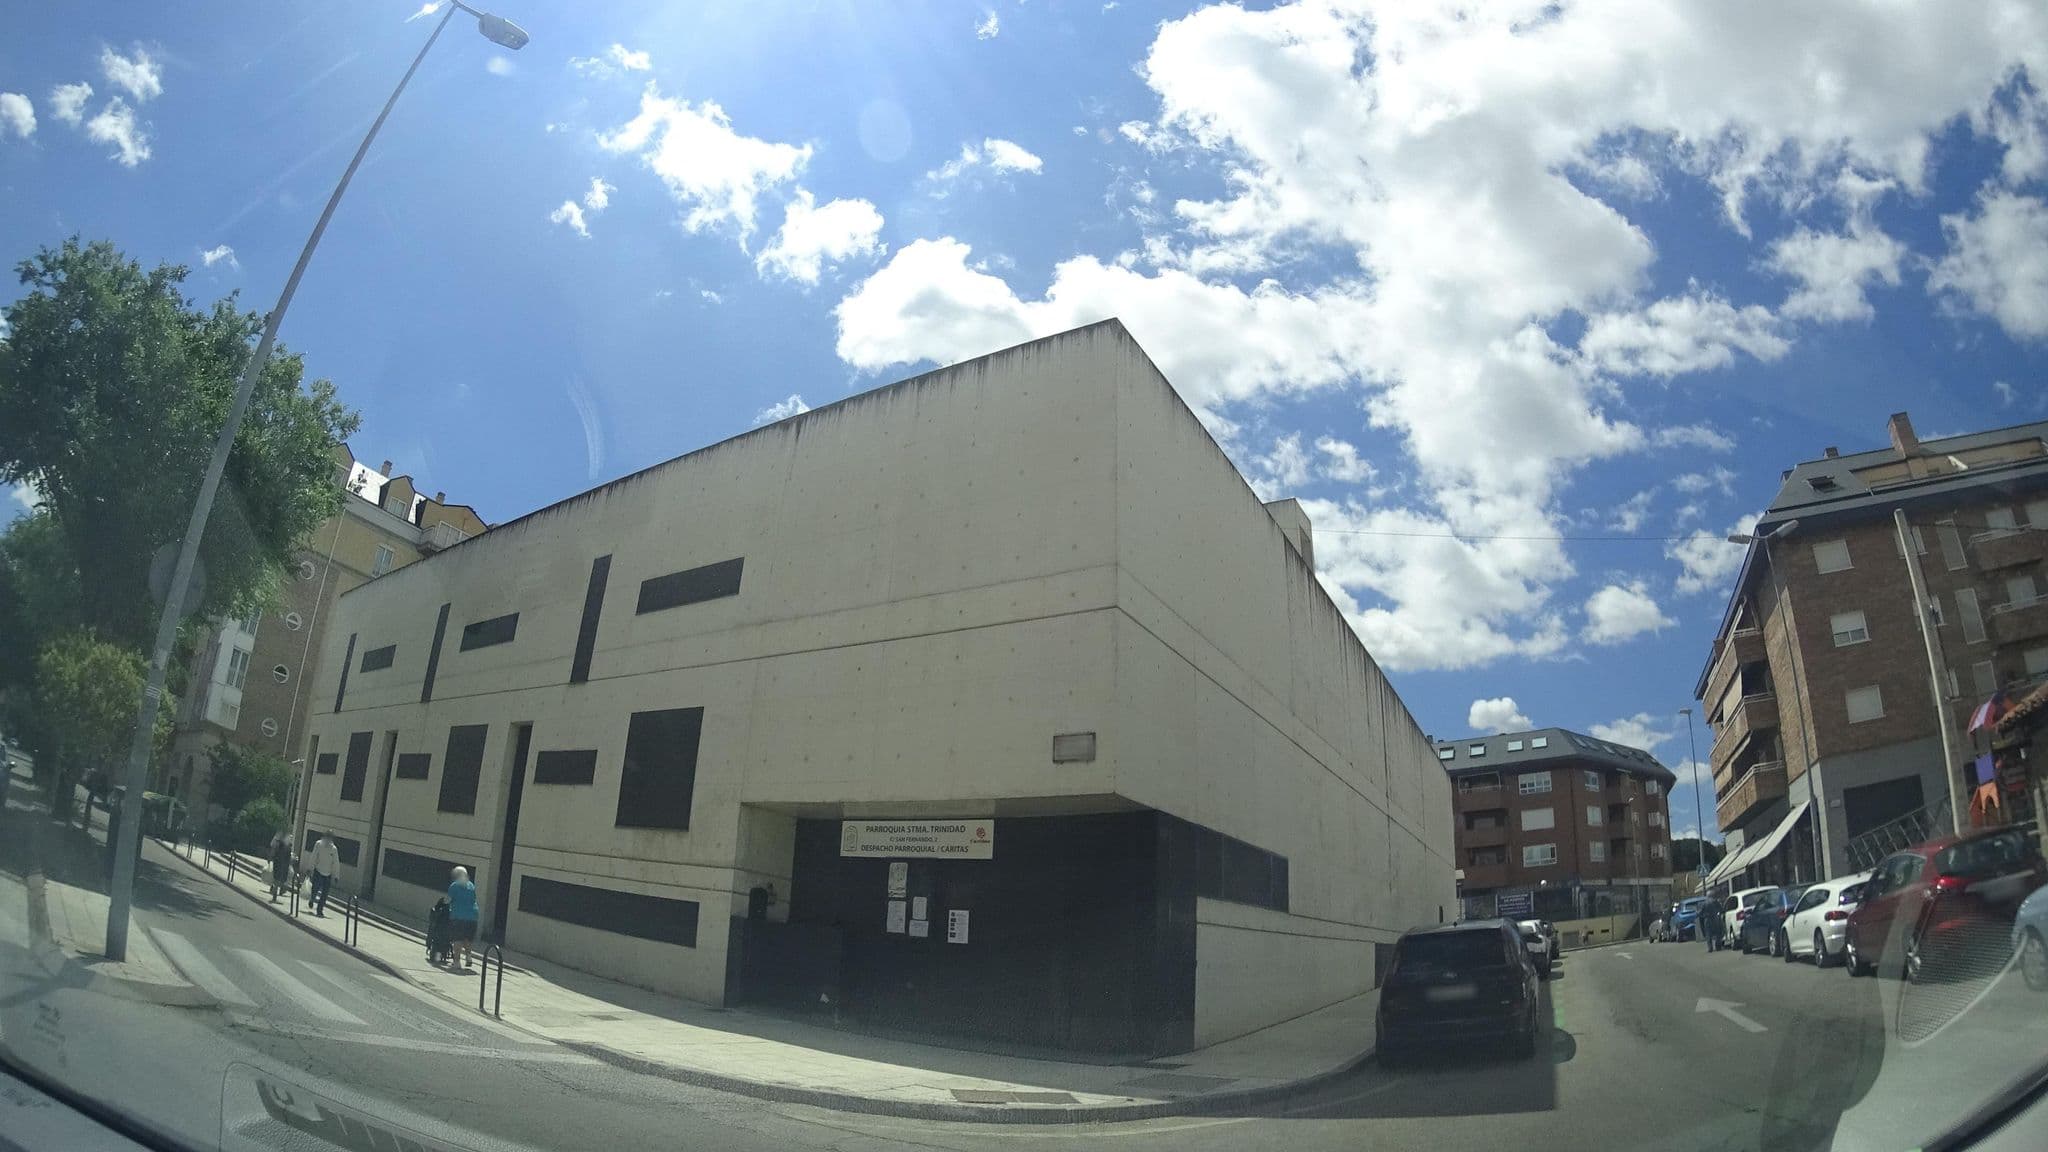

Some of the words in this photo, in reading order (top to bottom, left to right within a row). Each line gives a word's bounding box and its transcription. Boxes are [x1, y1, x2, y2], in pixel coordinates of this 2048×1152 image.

[866, 825, 905, 833] PARROQUIA
[907, 825, 929, 833] STMA.
[931, 825, 966, 833] TRINIDAD
[861, 844, 893, 852] DESPACHO
[894, 844, 935, 853] PARROQUIAL
